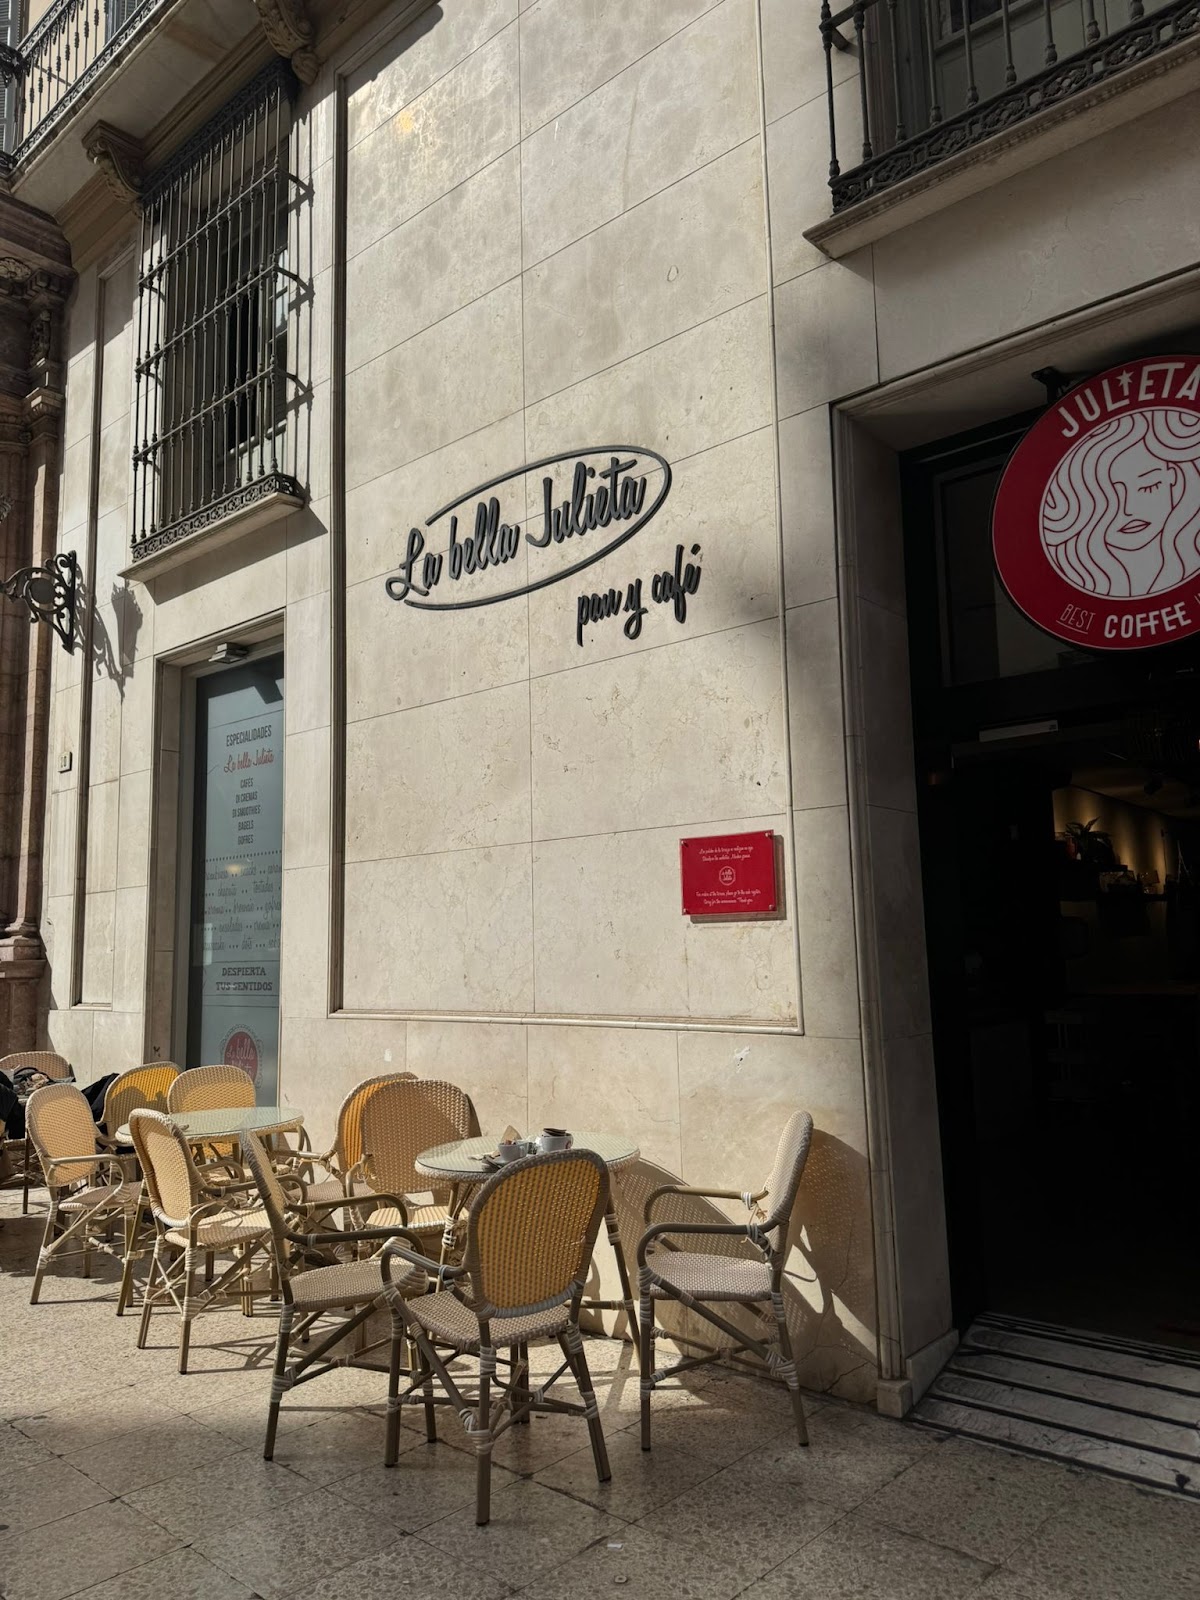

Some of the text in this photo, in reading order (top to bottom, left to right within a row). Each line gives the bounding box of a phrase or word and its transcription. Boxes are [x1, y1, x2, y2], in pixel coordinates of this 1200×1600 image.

[385, 456, 647, 600] La bella Julieta
[576, 543, 702, 648] pan y café
[1060, 602, 1192, 639] BEST COFFEE
[226, 724, 272, 747] ESPECIALIDADES
[224, 747, 274, 773] La bella Julieta
[238, 820, 254, 831] BAGELS
[237, 834, 254, 845] GOFRES
[222, 967, 266, 977] DESPIERTA
[216, 982, 273, 991] TUS SENTIDOS
